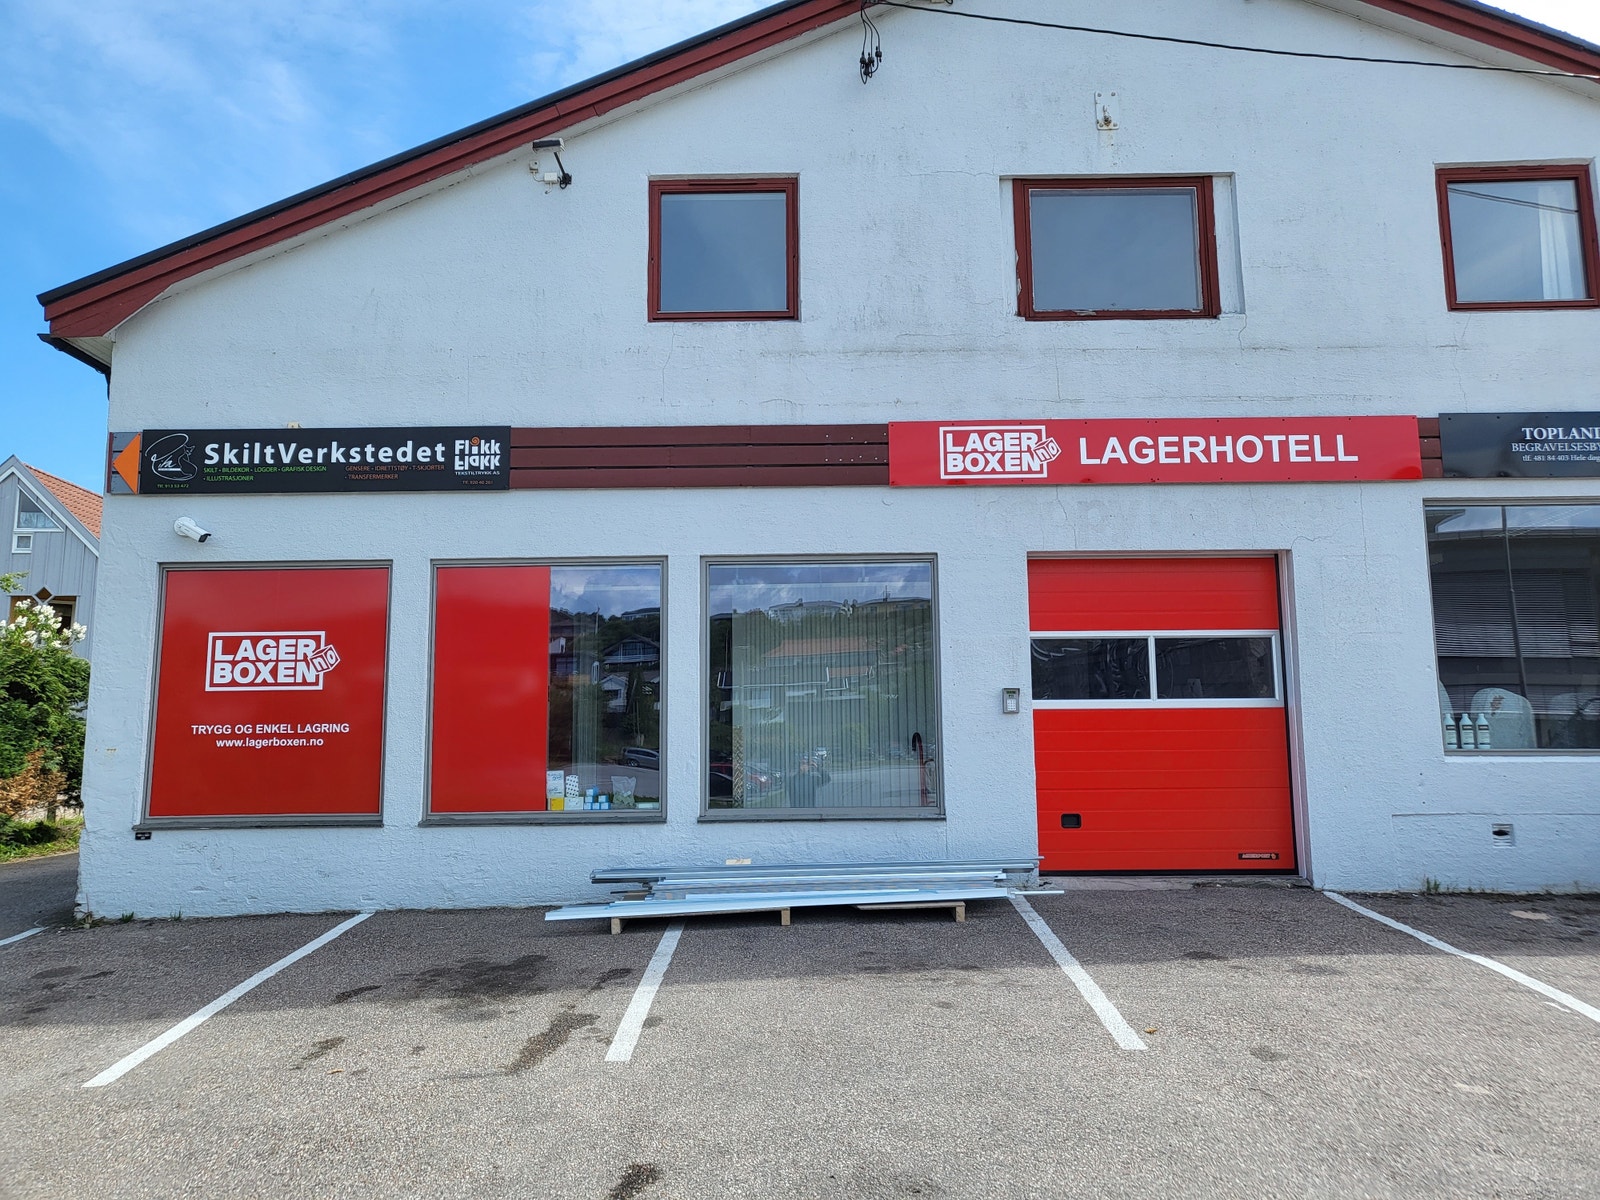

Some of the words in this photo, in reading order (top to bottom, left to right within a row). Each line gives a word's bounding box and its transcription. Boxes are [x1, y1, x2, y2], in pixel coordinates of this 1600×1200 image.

[454, 436, 501, 455] Flikk
[945, 432, 1039, 452] LAGER
[1079, 434, 1359, 465] LAGERHOTELL
[204, 440, 446, 465] SkiltVerkstedet
[946, 452, 1041, 473] BOXEN
[281, 465, 305, 473] GRAFISK
[374, 464, 409, 472] IDRETTSTØY
[214, 638, 317, 661] LAGER
[212, 661, 317, 684] BOXEN
[191, 724, 232, 735] TRYGG
[234, 724, 253, 734] OG
[255, 724, 294, 734] ENKEL
[297, 723, 350, 733] LAGRING
[215, 737, 324, 749] www.lagerboxen.no
